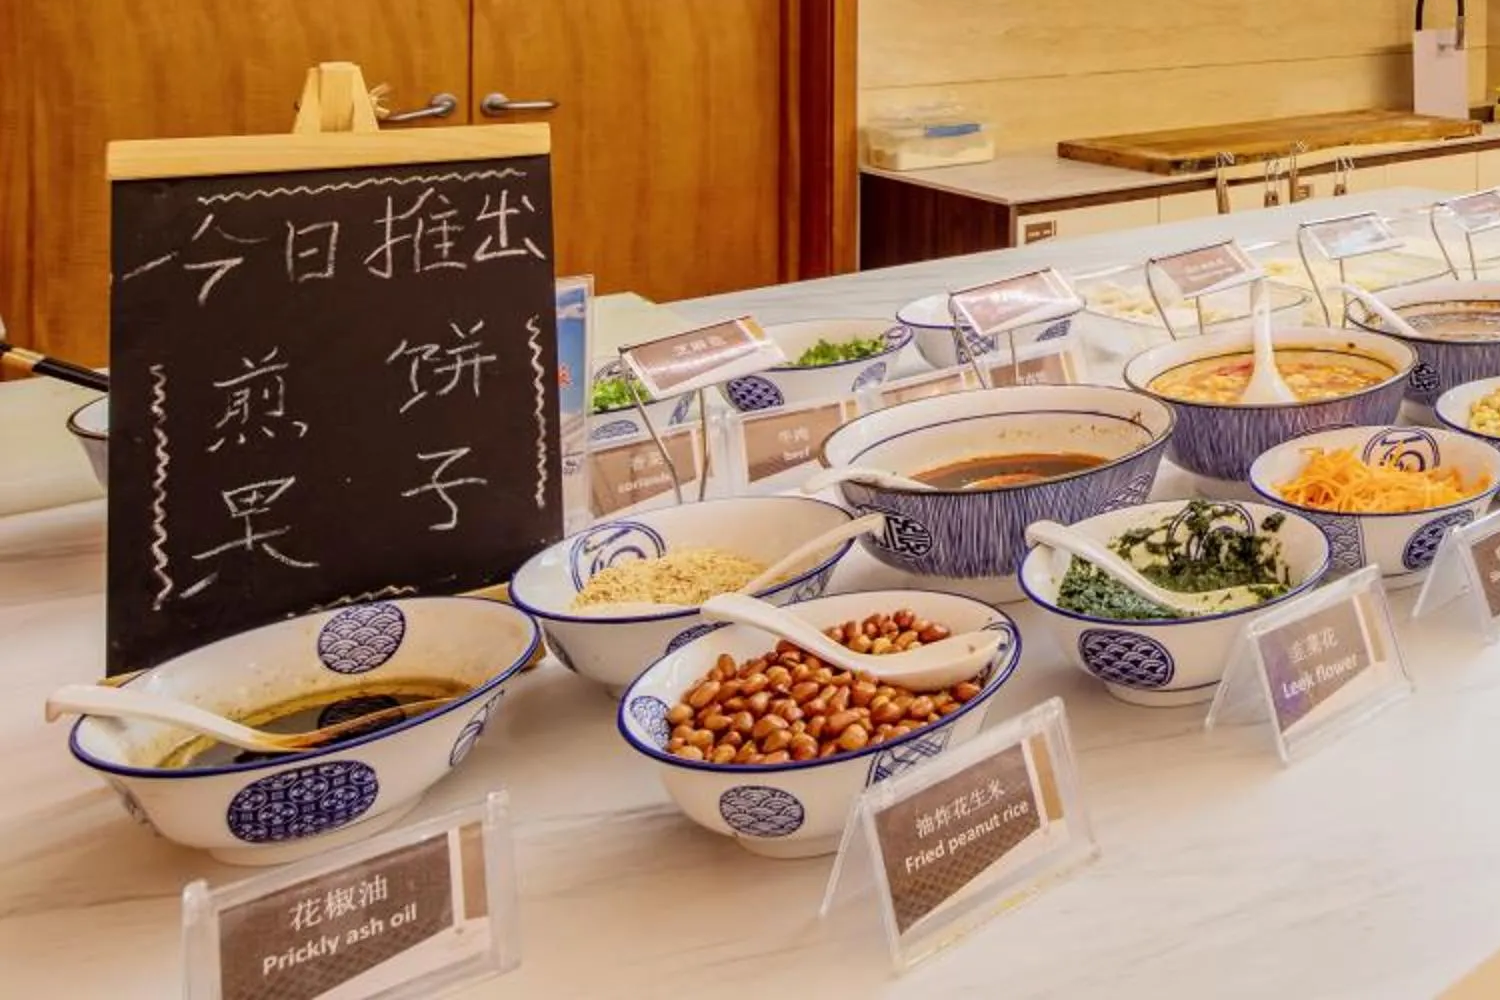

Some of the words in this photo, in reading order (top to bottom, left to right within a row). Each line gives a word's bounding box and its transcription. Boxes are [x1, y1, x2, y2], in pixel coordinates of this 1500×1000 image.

[183, 187, 545, 304] 今日推出
[1315, 653, 1358, 682] flower
[905, 840, 946, 874] Fried
[949, 814, 1002, 856] peanut
[1003, 799, 1030, 824] rice
[915, 778, 1006, 840] 油炸花生米
[288, 874, 389, 932] 花椒油
[262, 934, 341, 976] Prickly
[346, 916, 384, 946] ash
[390, 902, 418, 930] oil
